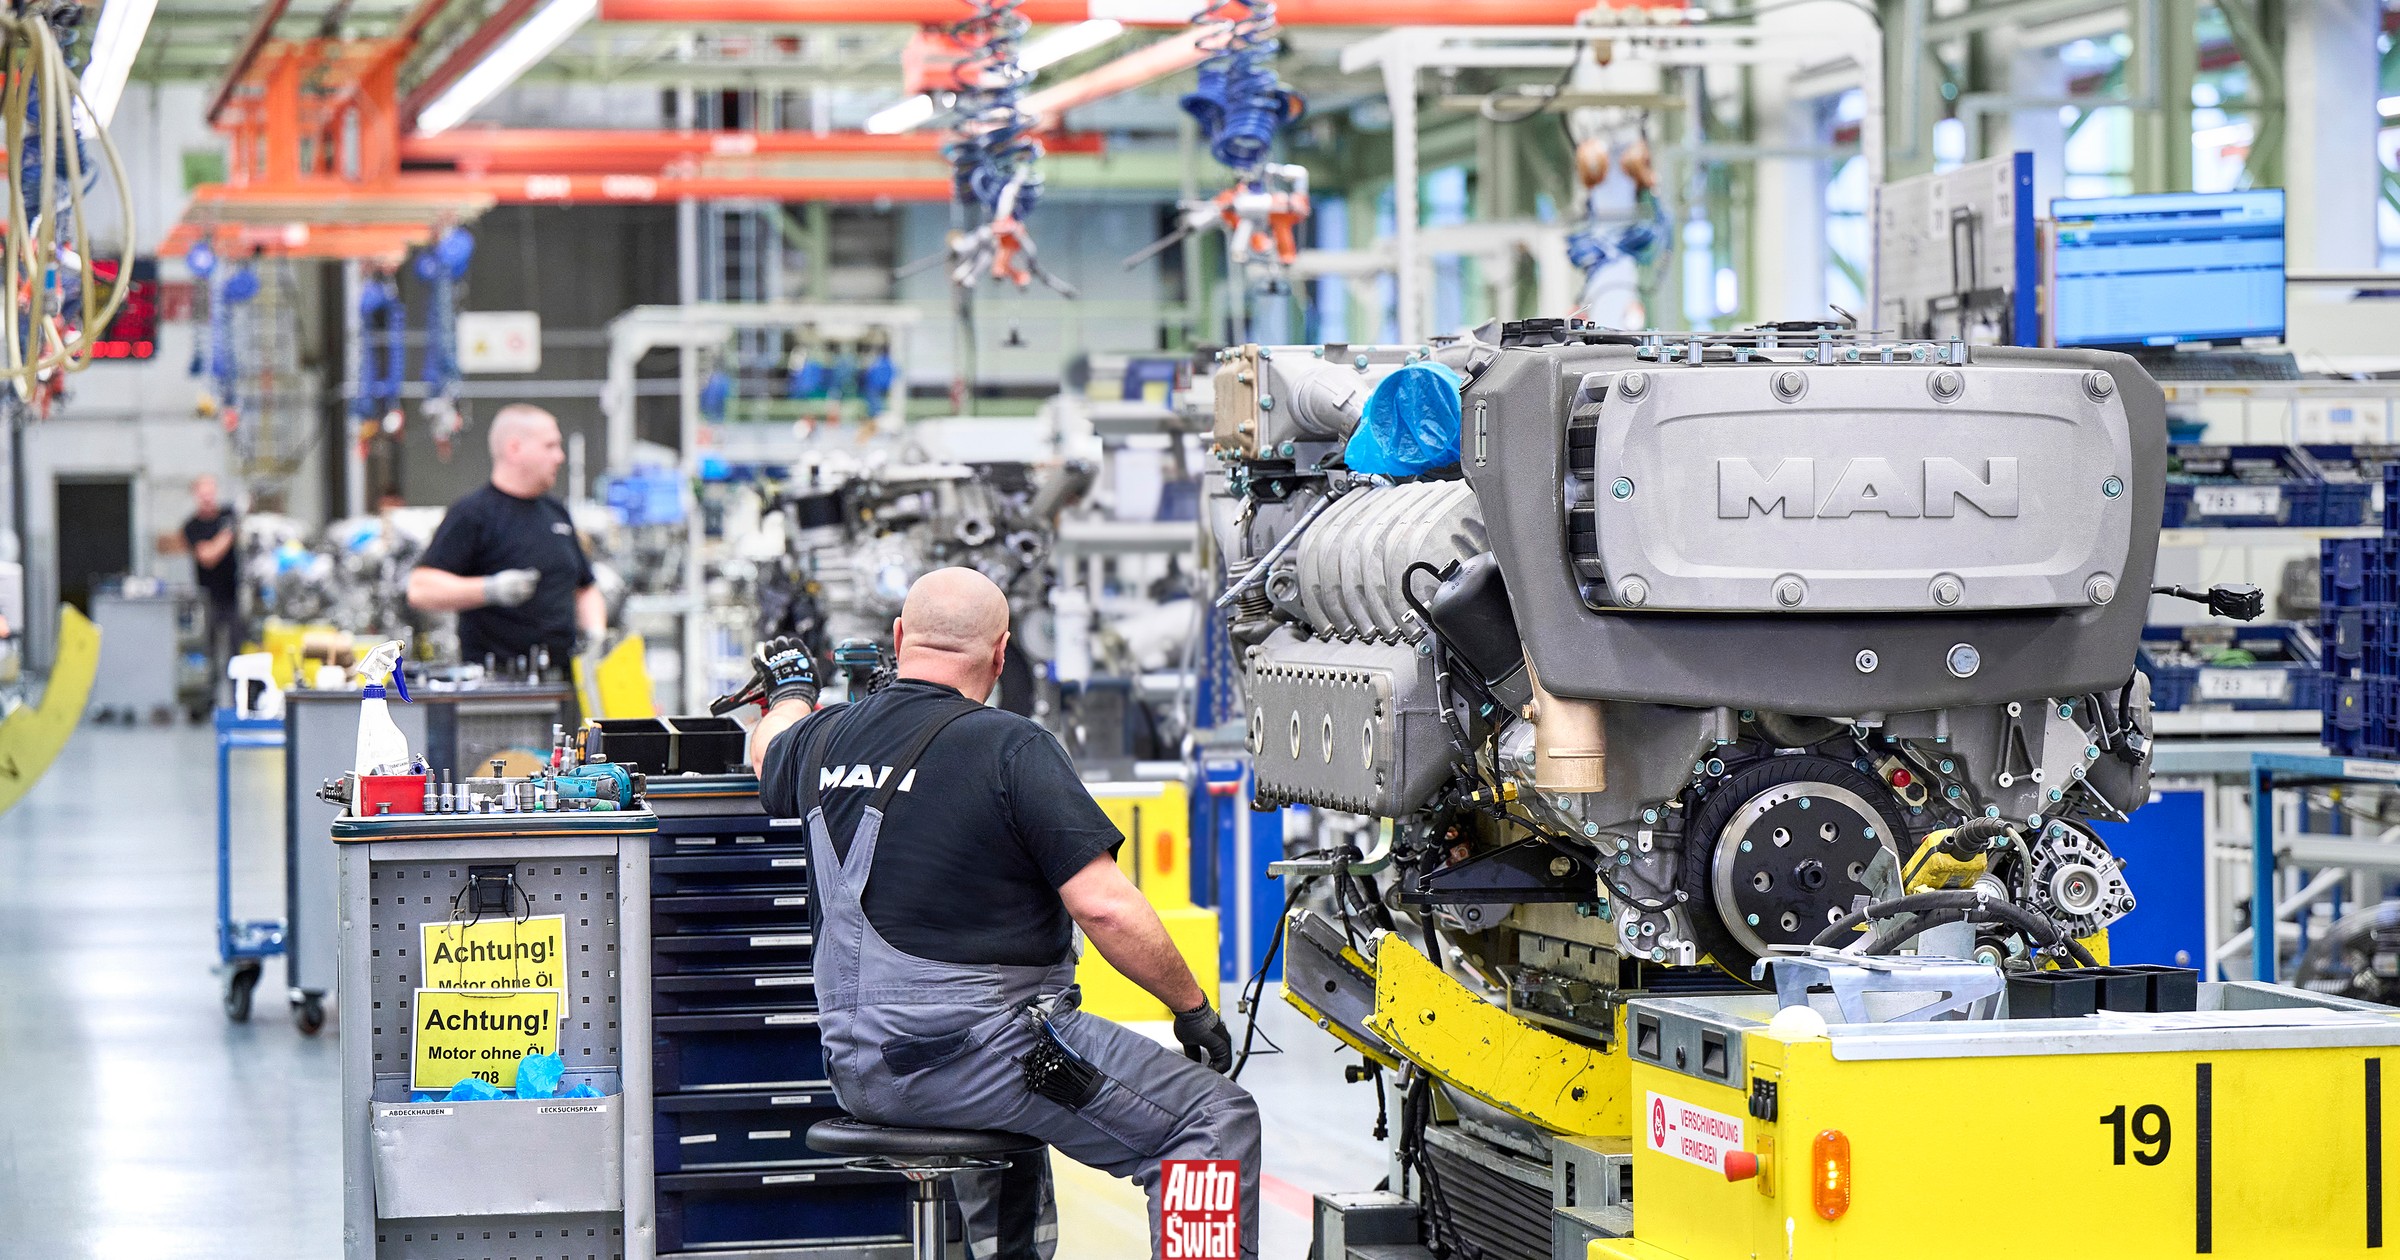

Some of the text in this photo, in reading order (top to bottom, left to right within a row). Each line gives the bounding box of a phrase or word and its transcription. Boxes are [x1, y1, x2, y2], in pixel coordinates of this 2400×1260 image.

[1717, 456, 2019, 519] MAN
[765, 648, 801, 667] uvex
[433, 935, 555, 964] Achtung!
[491, 976, 531, 989] ohne
[536, 971, 553, 987] Öl
[425, 1009, 549, 1036] Achtung!
[428, 1043, 544, 1060] Motor ohne Öl
[388, 1108, 445, 1116] ABDECKHAUBEN
[540, 1105, 598, 1114] LECKSUCHSPRAY
[1680, 1108, 1738, 1143] VERSCHWENDUNG
[2099, 1103, 2172, 1166] 19
[1680, 1136, 1718, 1165] VERMEIDEN
